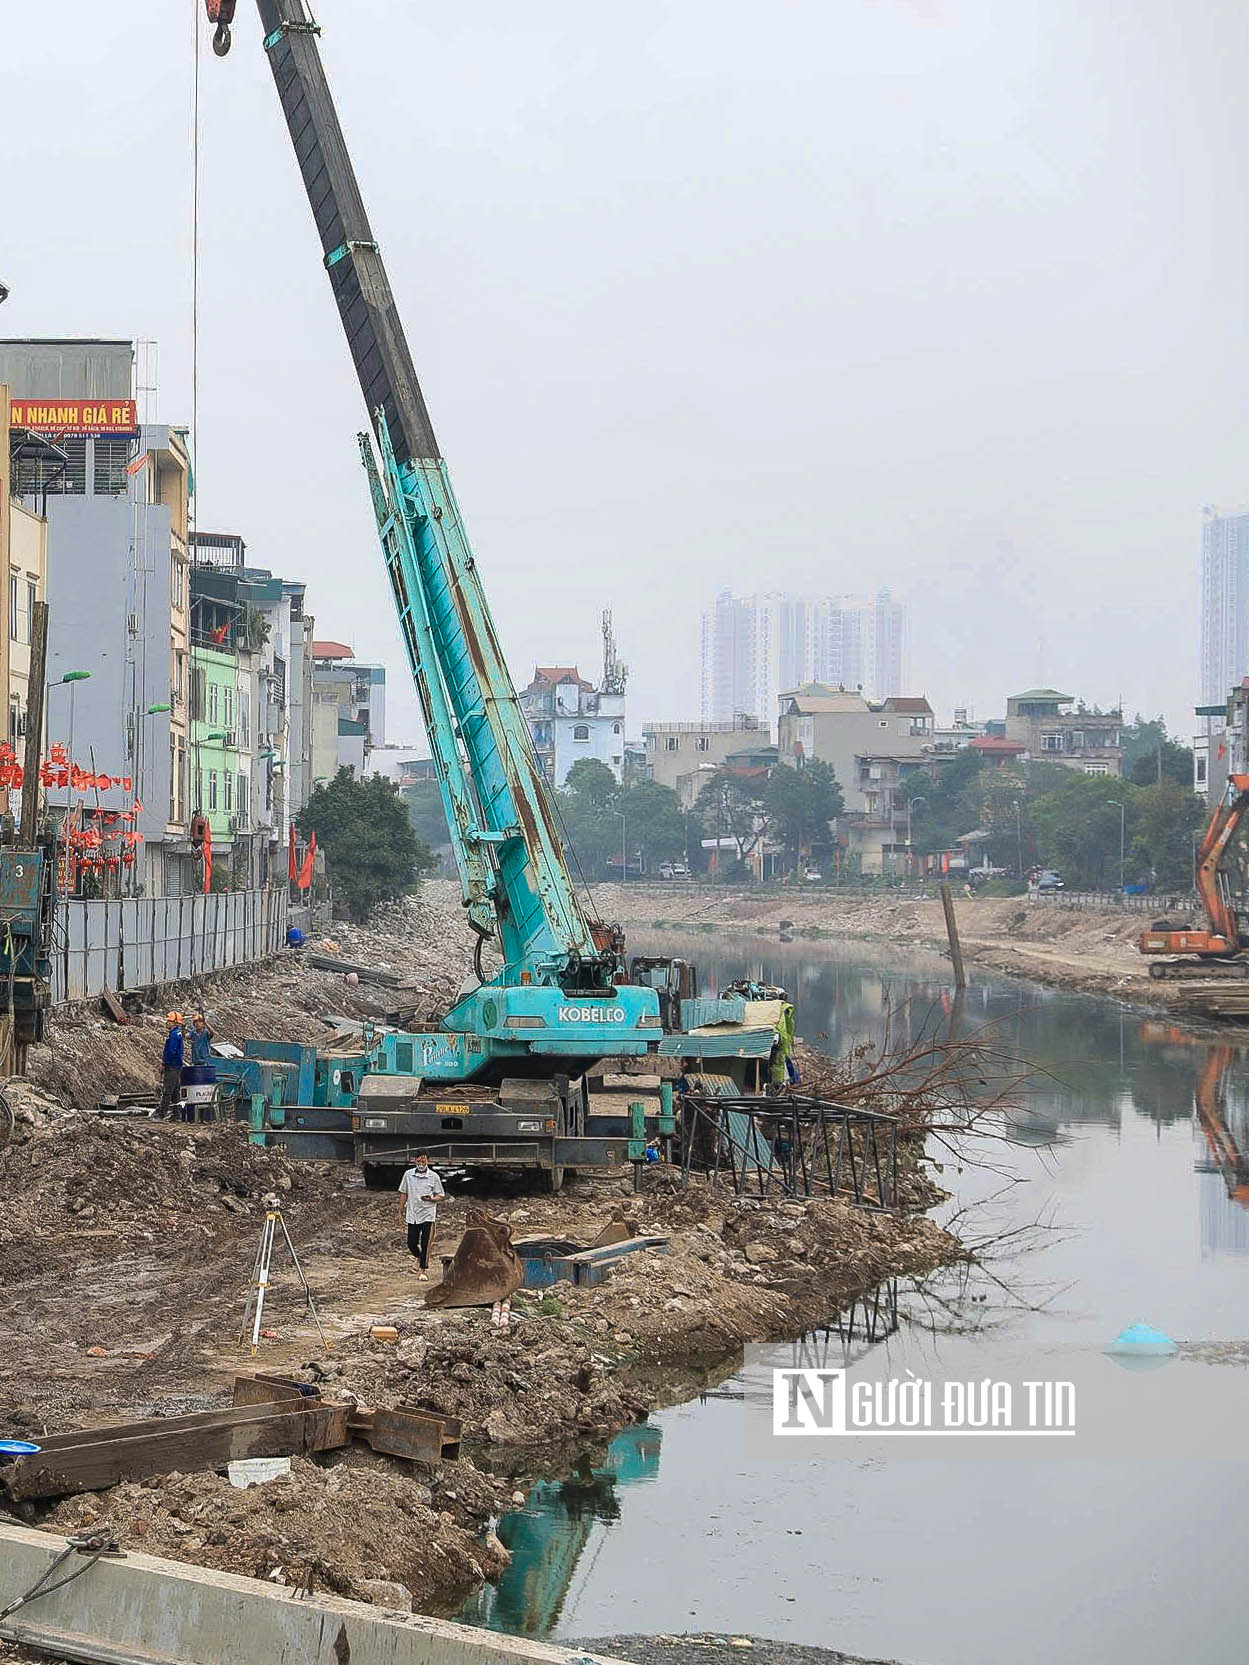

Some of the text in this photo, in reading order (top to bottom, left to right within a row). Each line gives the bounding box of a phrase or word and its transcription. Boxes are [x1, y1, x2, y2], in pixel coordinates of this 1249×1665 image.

[27, 407, 78, 424] NHANH
[82, 404, 108, 424] GIÁ
[112, 401, 130, 424] RẺ
[15, 865, 24, 878] 3
[559, 1007, 625, 1022] KOBELCO
